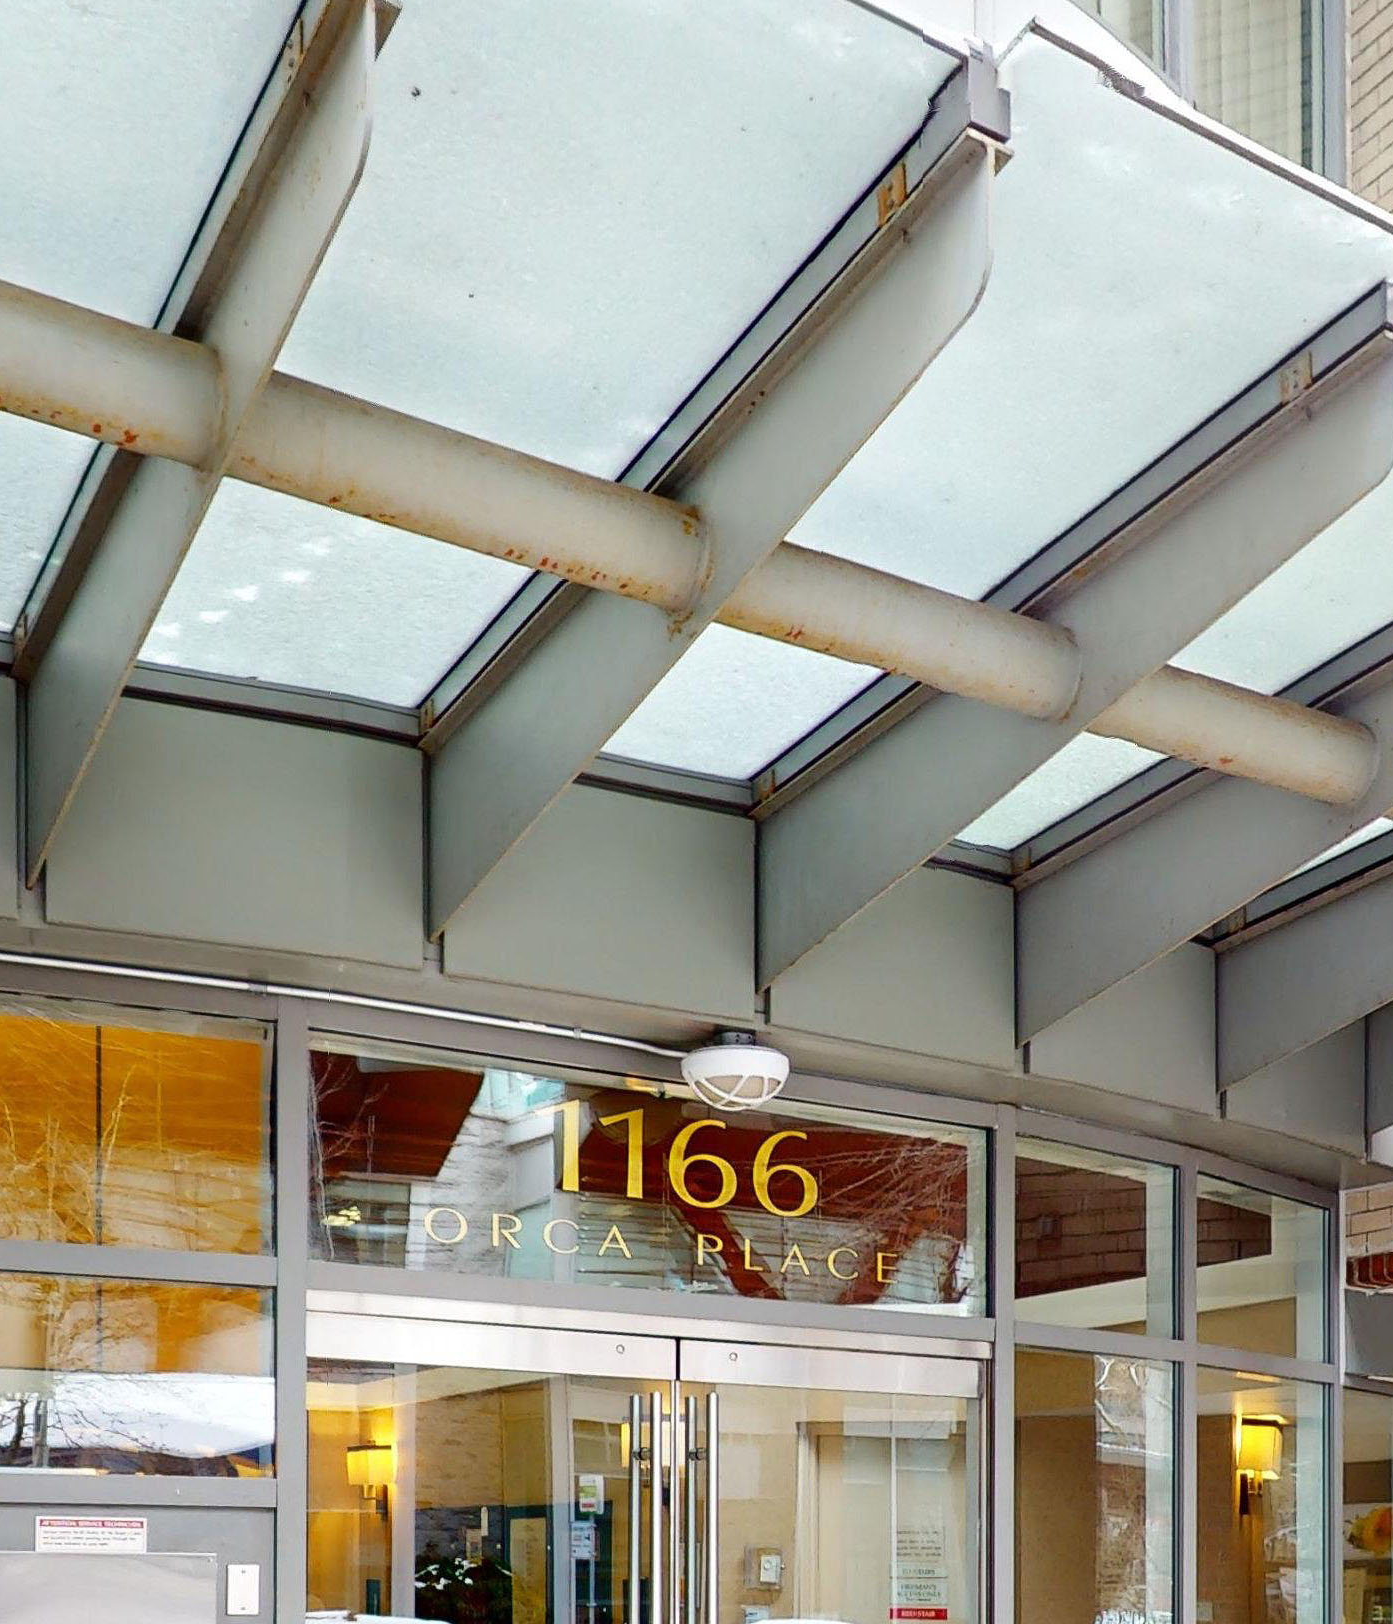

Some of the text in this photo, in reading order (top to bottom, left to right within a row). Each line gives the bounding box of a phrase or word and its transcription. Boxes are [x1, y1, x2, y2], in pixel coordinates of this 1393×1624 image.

[534, 1098, 819, 1218] 1166
[424, 1207, 899, 1286] ORCA PLACE
